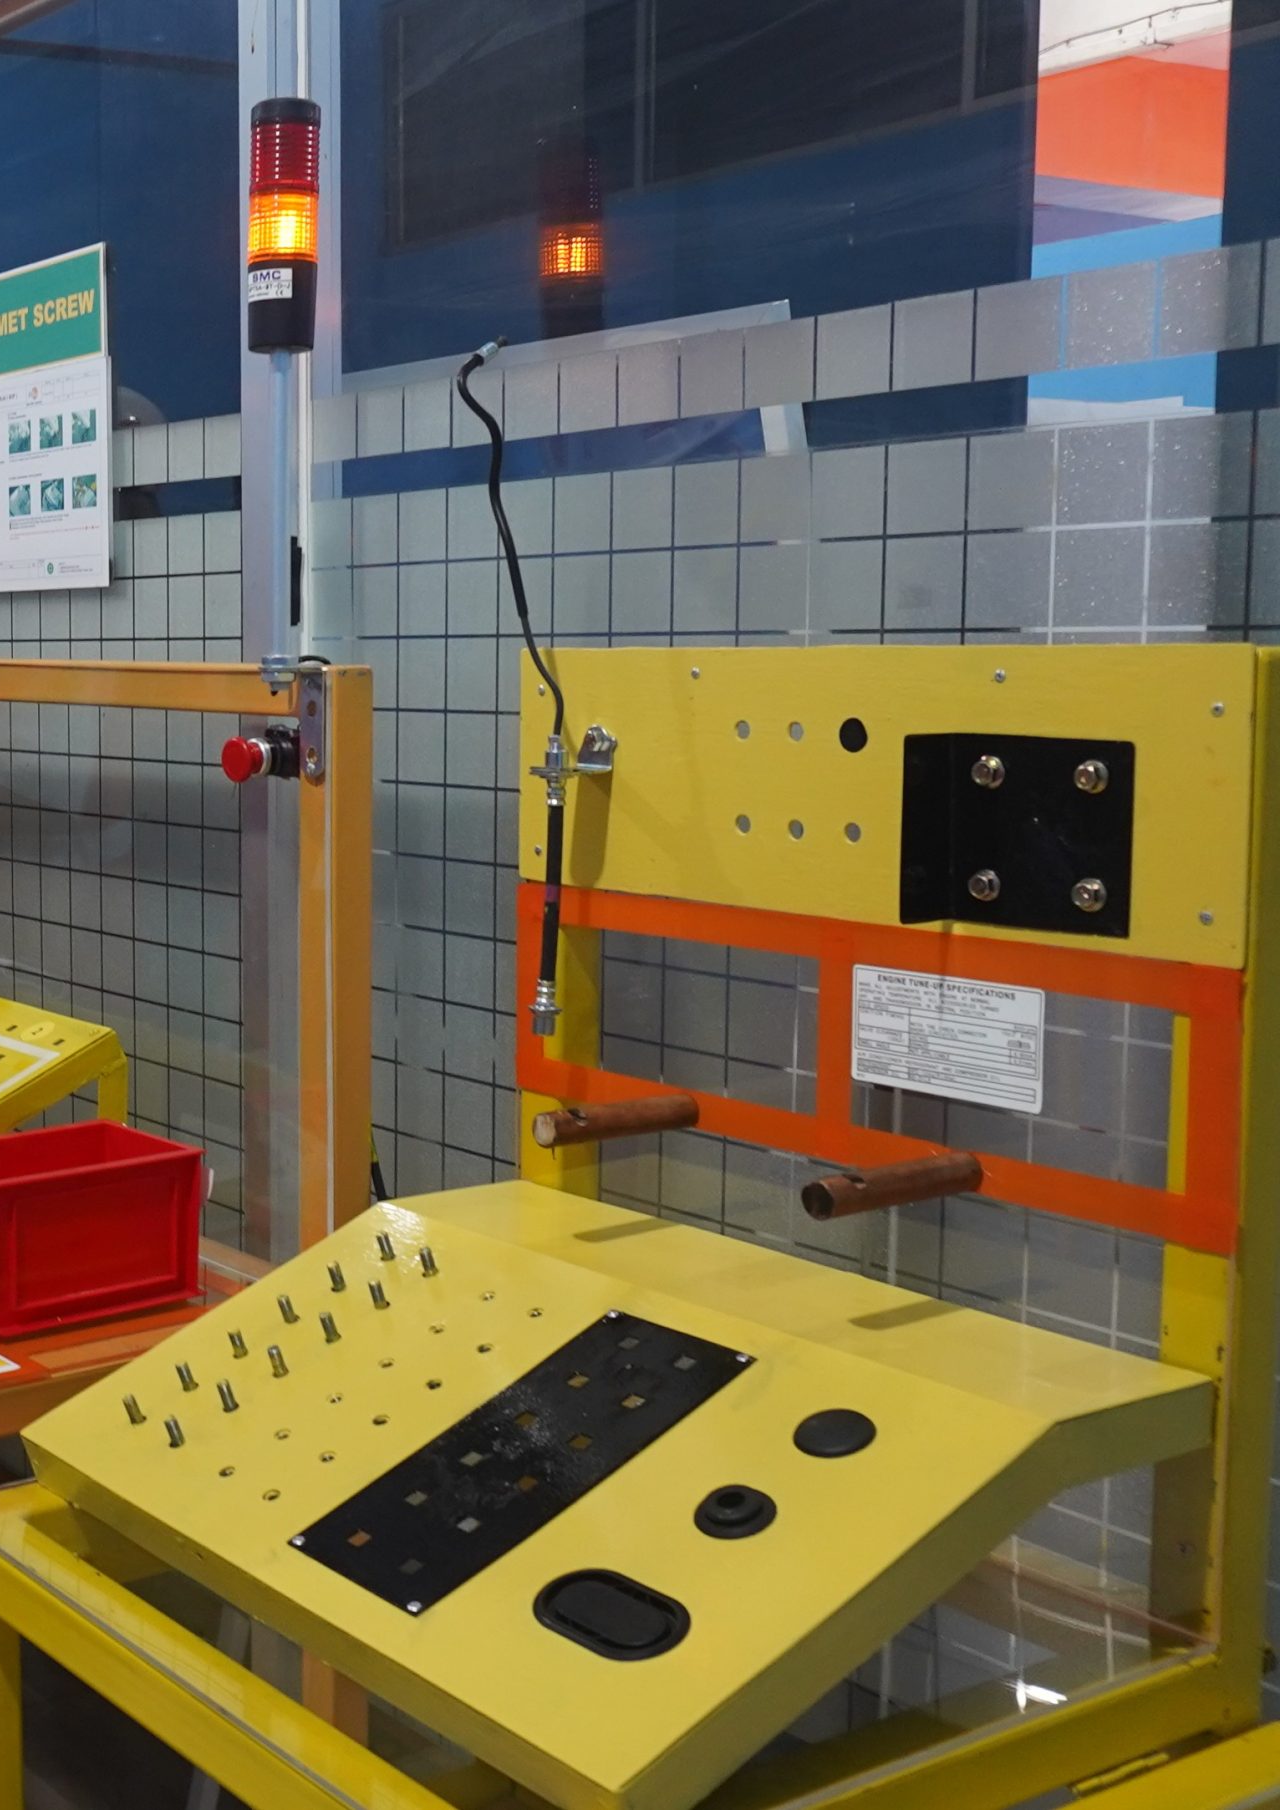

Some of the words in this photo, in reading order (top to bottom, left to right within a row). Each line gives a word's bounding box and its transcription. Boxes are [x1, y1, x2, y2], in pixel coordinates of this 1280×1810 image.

[33, 288, 95, 328] SCREW
[877, 974, 906, 985] ENGINE
[946, 983, 1016, 1000] SPECIFICATIONS
